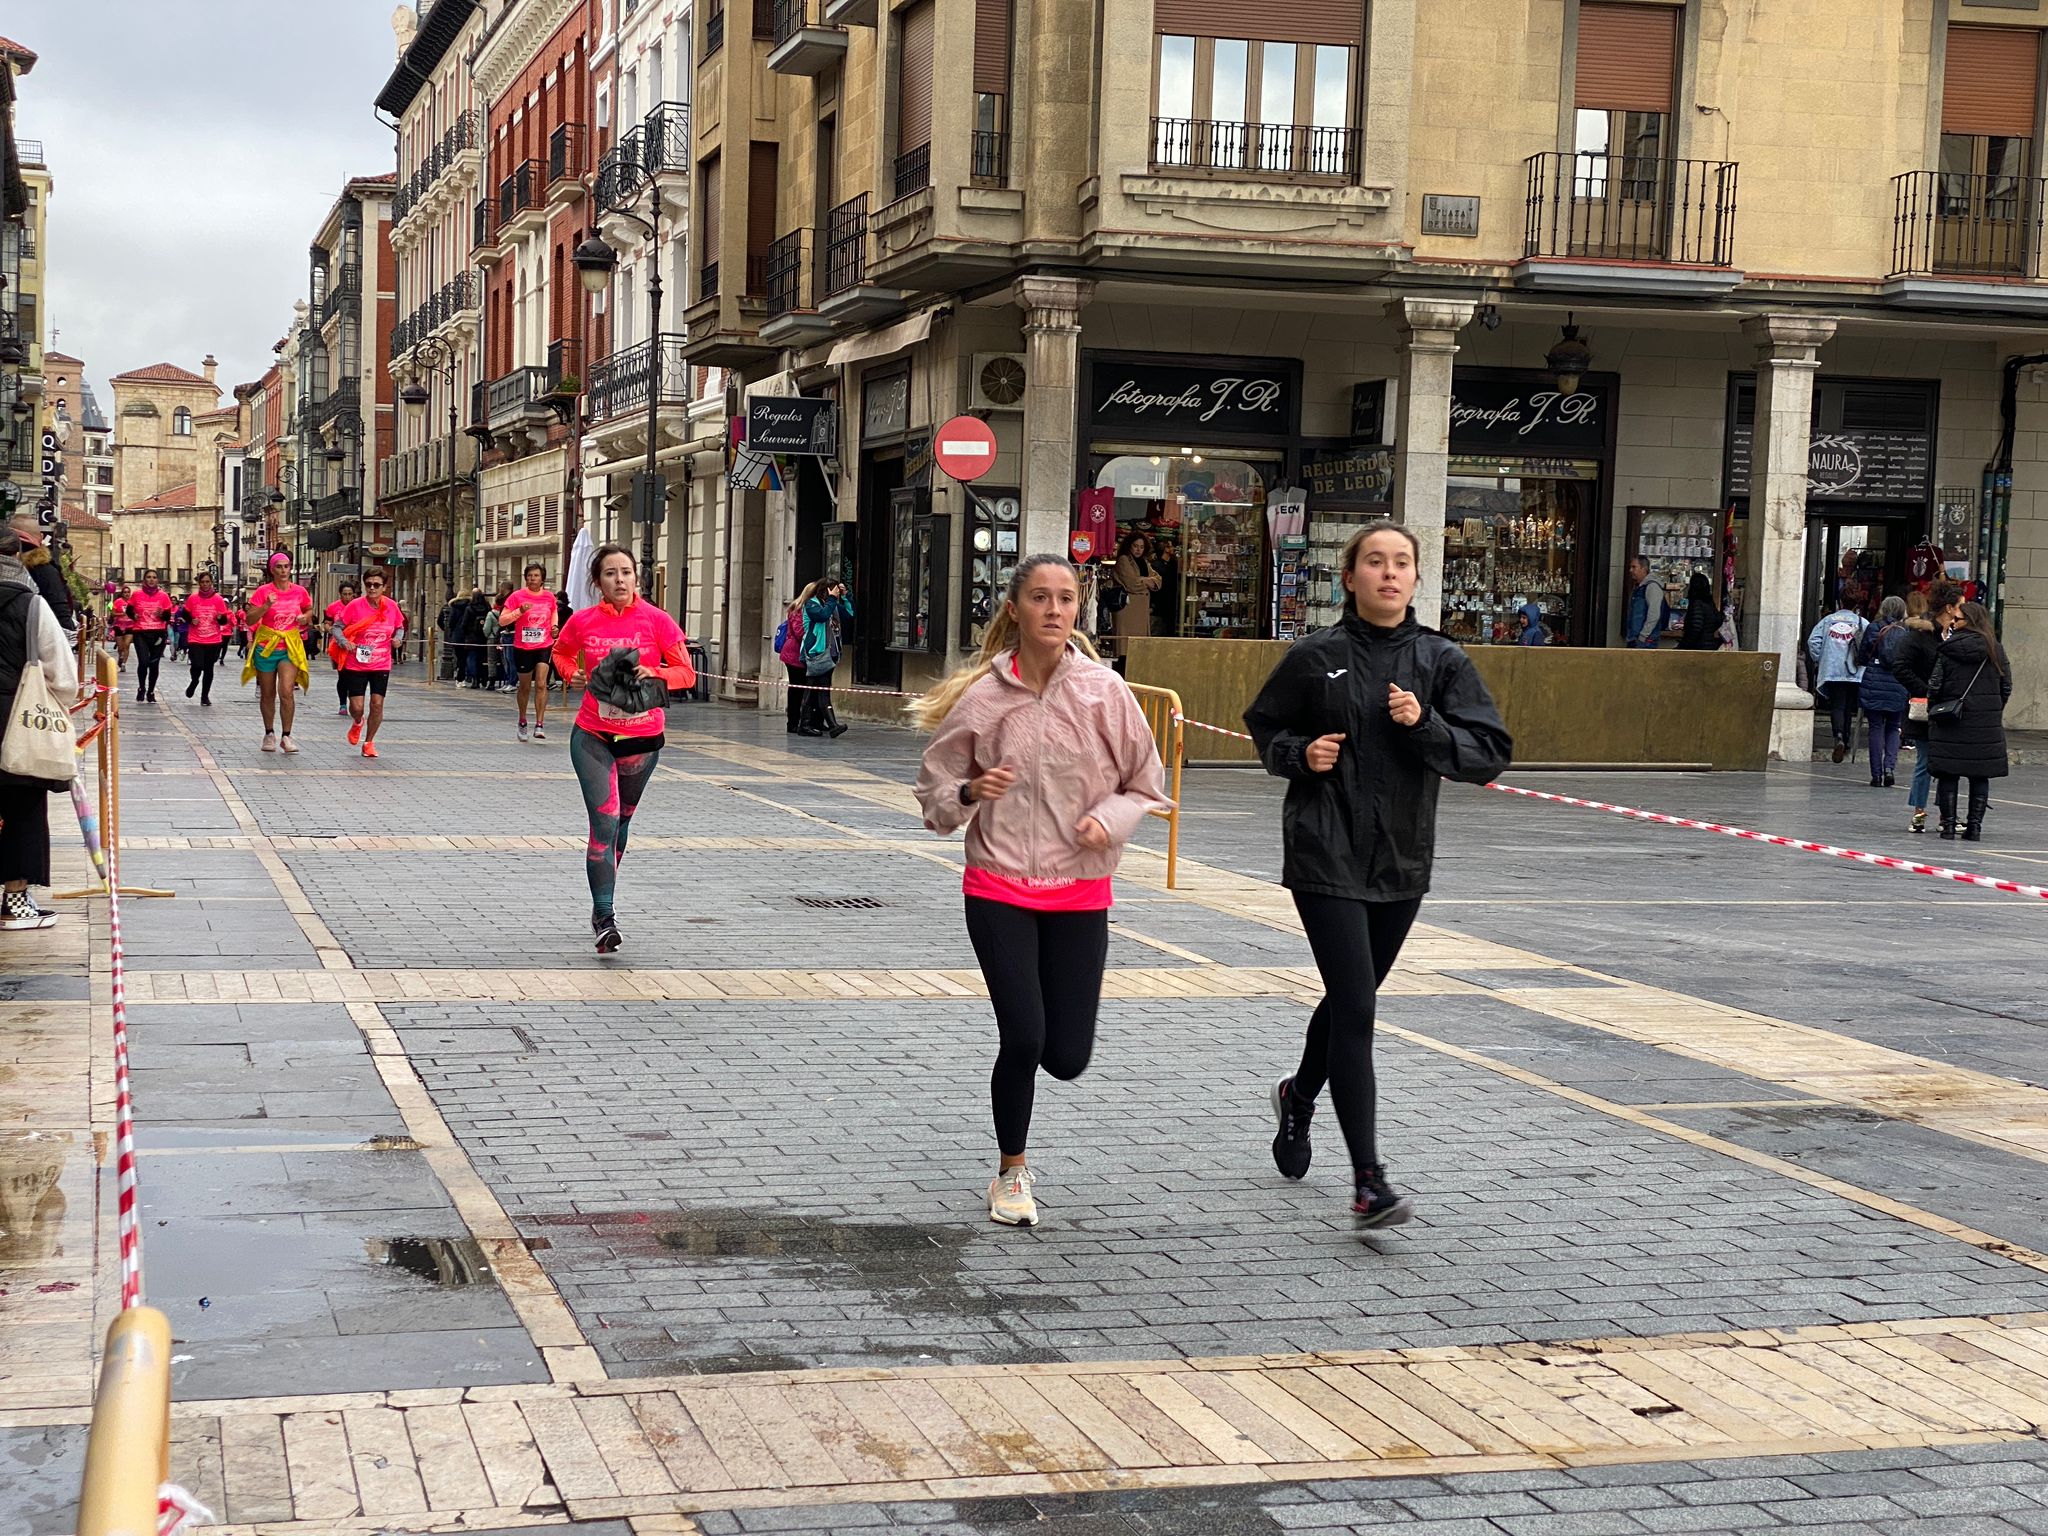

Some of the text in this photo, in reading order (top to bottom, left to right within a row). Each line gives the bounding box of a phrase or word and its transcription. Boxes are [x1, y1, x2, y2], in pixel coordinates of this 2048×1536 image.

[1435, 209, 1466, 217] PLAZA
[1427, 220, 1473, 230] DE REGLA
[753, 404, 803, 426] Regalos
[752, 429, 808, 446] Souvenir
[1302, 454, 1396, 478] RECUERDOS
[1811, 452, 1849, 471] NAURA
[1314, 474, 1388, 494] DE LEON
